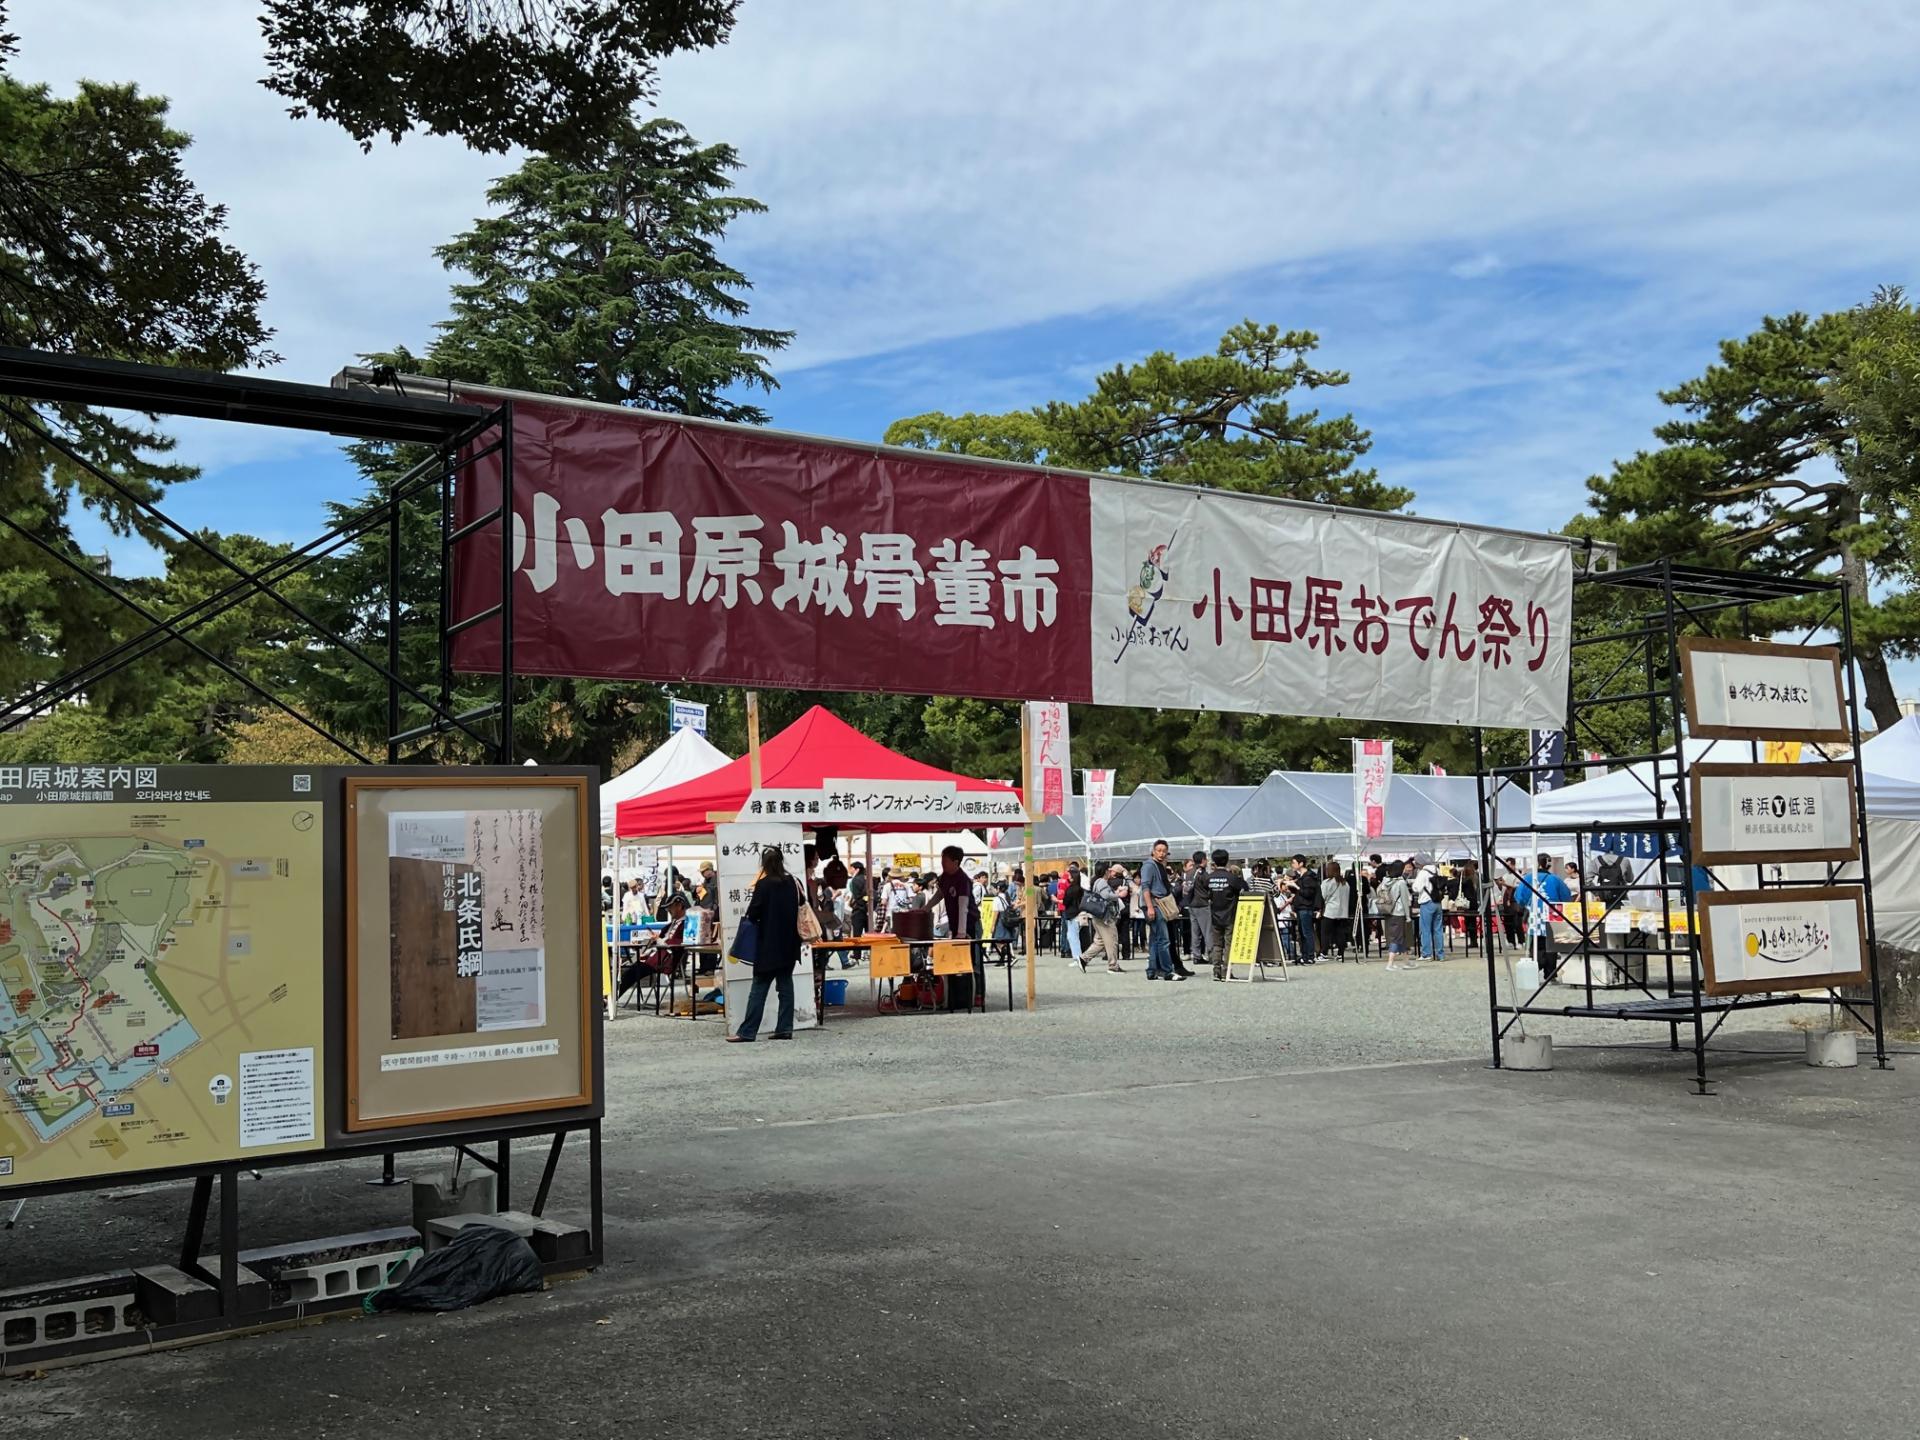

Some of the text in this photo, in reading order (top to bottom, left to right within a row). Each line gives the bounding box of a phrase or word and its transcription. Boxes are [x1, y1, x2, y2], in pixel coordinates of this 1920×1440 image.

[512, 491, 1060, 633] 小田原城骨董市
[1192, 566, 1550, 672] 小田原おでん祭り
[0, 766, 158, 789] 田原城案内図
[750, 800, 820, 814] 骨董市会場
[829, 792, 955, 812] 本部・インフォメーション
[956, 801, 1021, 815] 小田原おでん会場
[442, 863, 456, 912] 関東の雄
[457, 872, 483, 977] 北条氏綱
